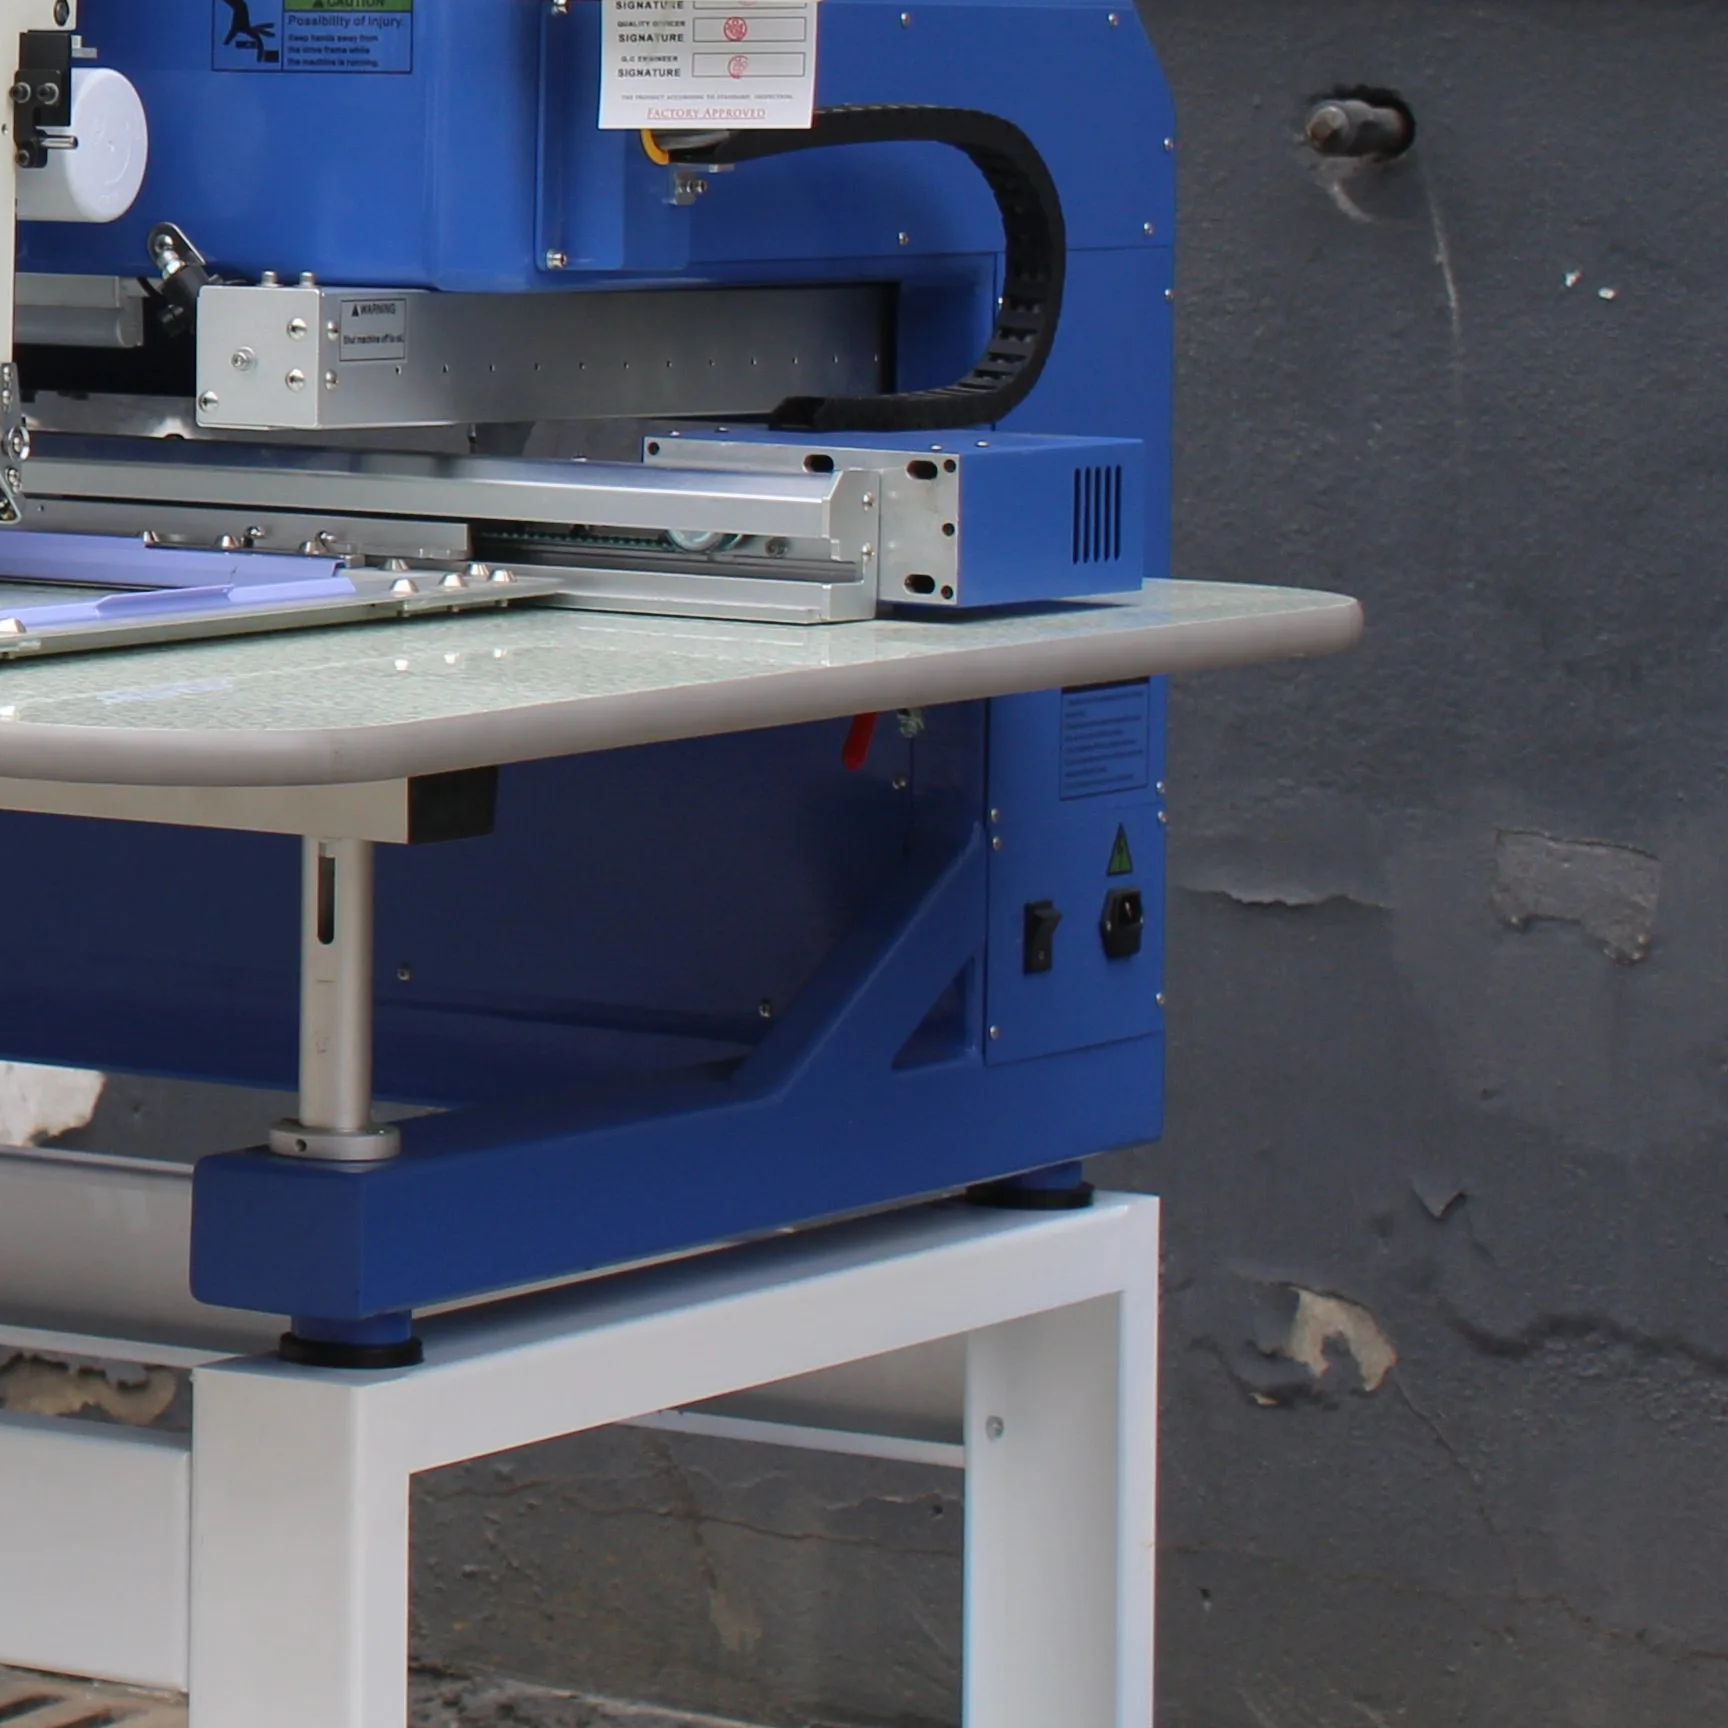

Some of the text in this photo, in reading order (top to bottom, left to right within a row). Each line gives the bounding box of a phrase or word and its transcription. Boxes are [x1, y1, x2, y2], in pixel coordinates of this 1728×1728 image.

[287, 14, 351, 29] Possibility
[352, 15, 366, 26] of
[652, 20, 686, 28] OICER
[618, 33, 684, 43] SIGNATURE
[617, 68, 681, 78] SIGNATURE
